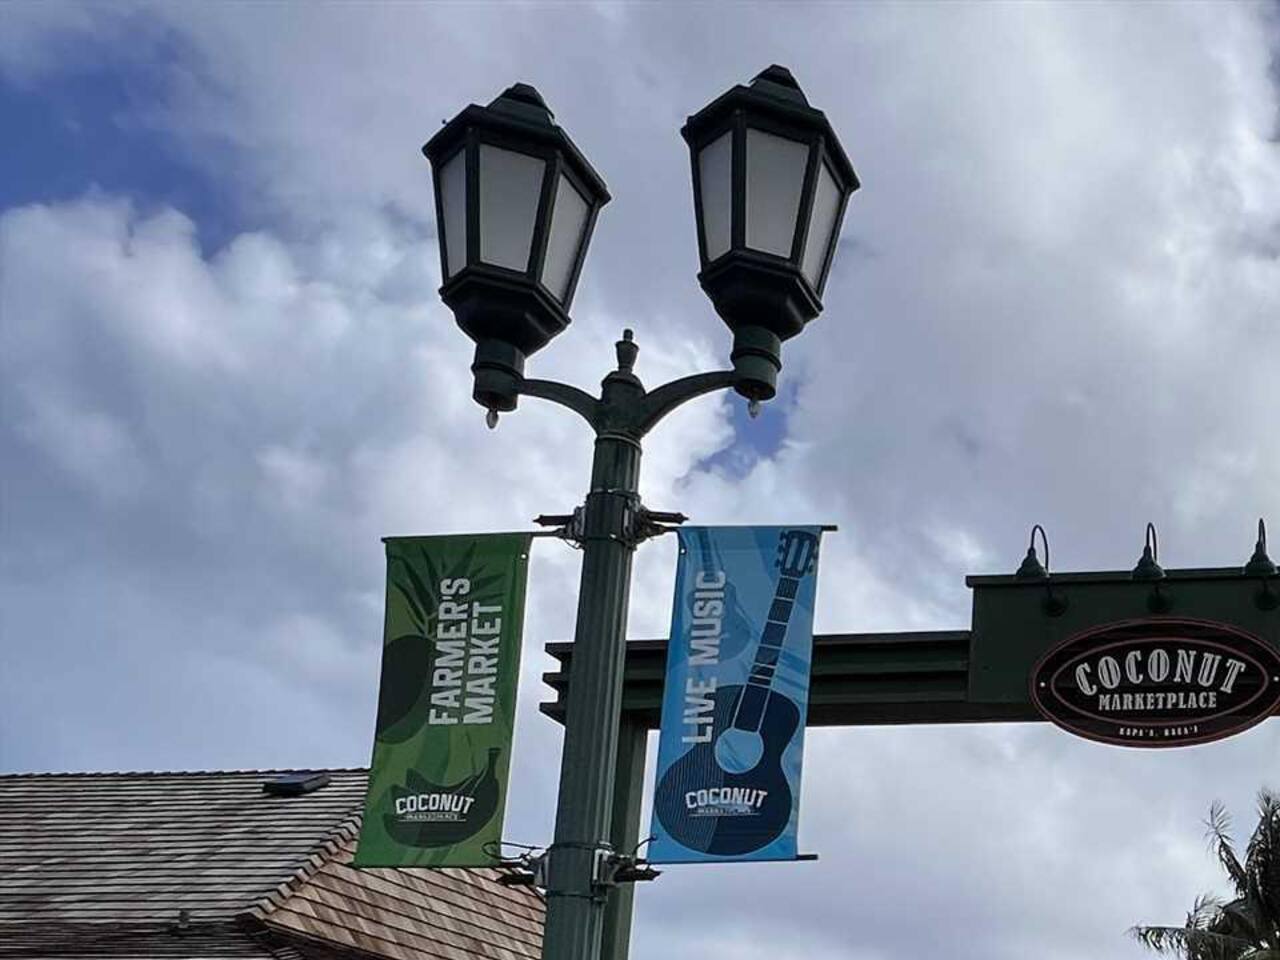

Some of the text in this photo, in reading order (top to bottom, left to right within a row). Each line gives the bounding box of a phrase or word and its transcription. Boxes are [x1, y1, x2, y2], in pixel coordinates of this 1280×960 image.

[428, 577, 471, 727] FARMER'S
[462, 601, 502, 725] MARKET
[682, 570, 726, 745] LIVE MUSIC
[1075, 649, 1247, 696] COCONUT
[1098, 691, 1217, 711] MARKETPLACE
[396, 793, 475, 814] COCONUT
[685, 787, 768, 808] COCONUT
